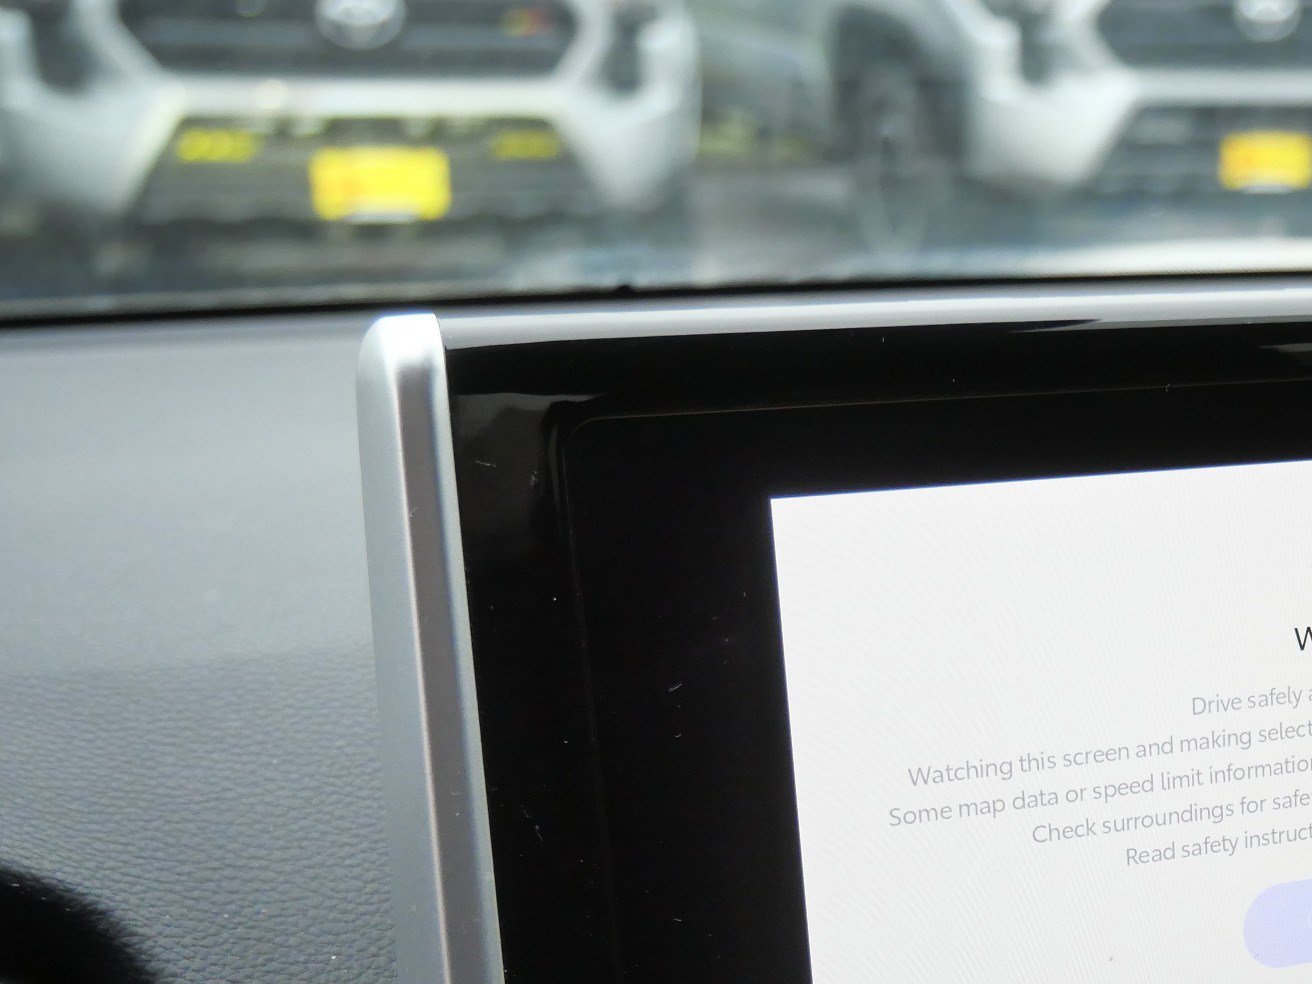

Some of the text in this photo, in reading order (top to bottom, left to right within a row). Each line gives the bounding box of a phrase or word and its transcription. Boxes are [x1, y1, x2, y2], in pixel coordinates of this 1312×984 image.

[1191, 693, 1242, 716] Drive
[1247, 685, 1303, 710] safely
[907, 758, 1013, 787] Watching
[1018, 751, 1057, 773] this
[1062, 746, 1130, 768] screen
[1135, 735, 1174, 759] and
[1179, 728, 1252, 753] making
[889, 805, 953, 827] Some
[958, 798, 1006, 825] map
[1012, 789, 1059, 811] data
[1065, 787, 1088, 804] or
[1092, 773, 1155, 804] speed
[1160, 767, 1204, 791] limit
[1031, 817, 1097, 844] Check
[1102, 802, 1235, 835] surroundings
[1239, 795, 1267, 815] for
[1125, 840, 1176, 867] Read
[1181, 835, 1239, 859] safety
